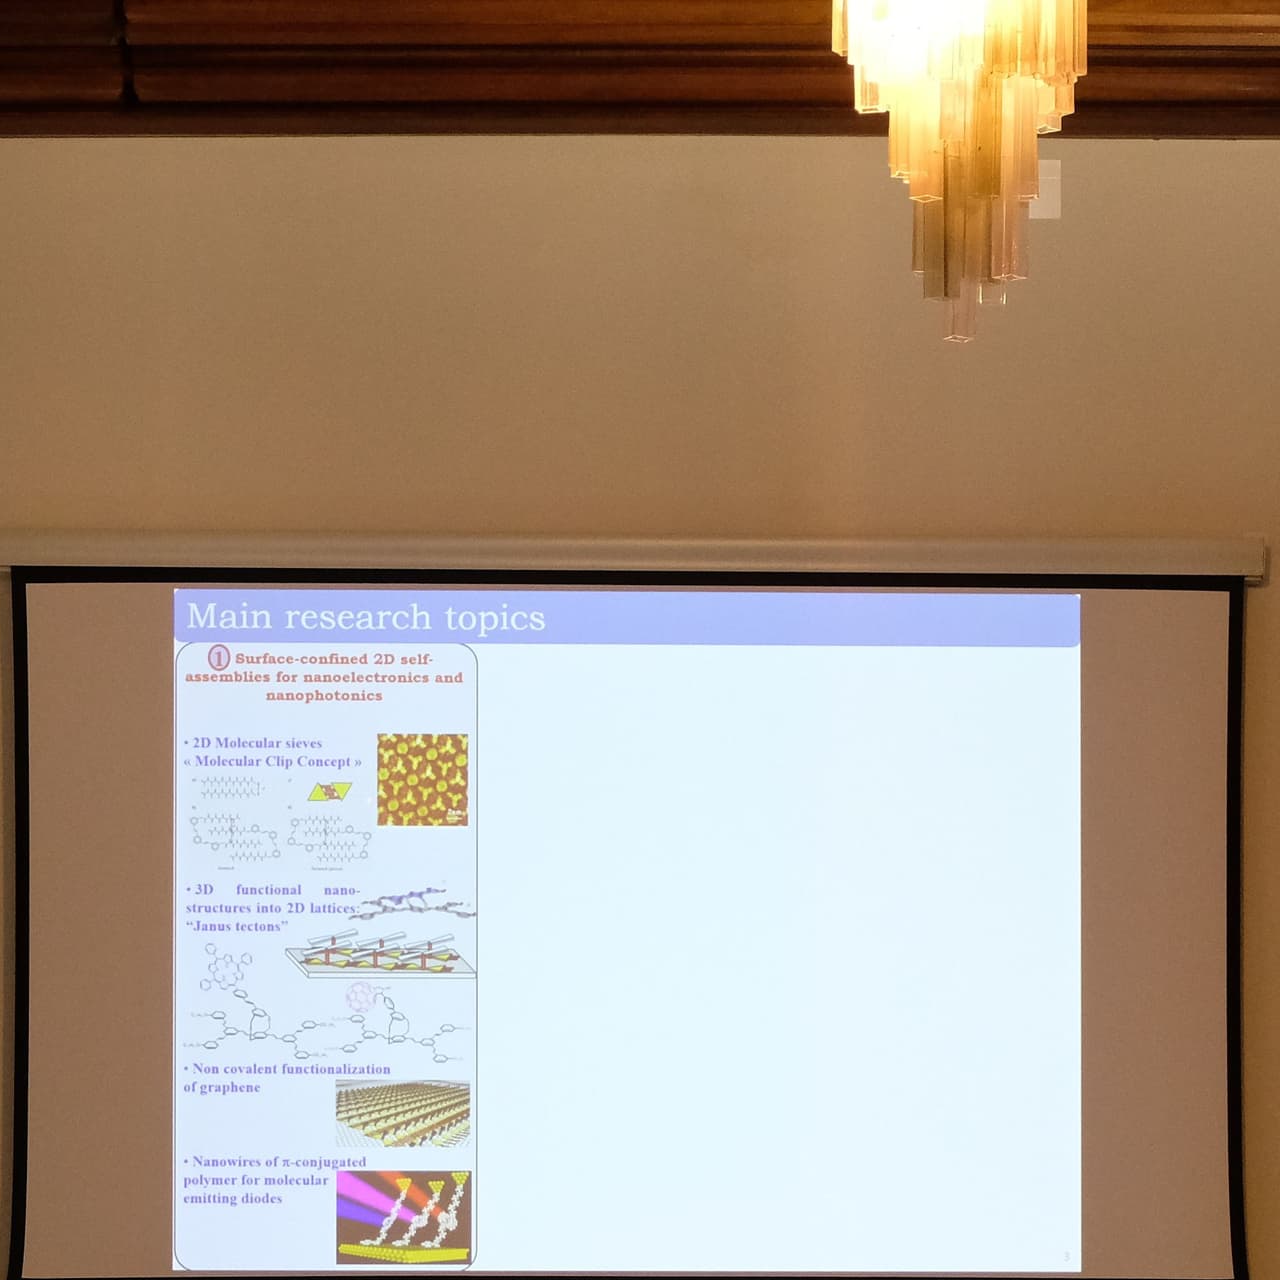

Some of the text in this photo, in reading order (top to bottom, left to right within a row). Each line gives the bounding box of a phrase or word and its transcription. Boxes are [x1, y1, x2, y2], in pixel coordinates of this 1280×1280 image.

[188, 602, 545, 638] Main research topics
[236, 653, 368, 665] Surface-confined
[374, 654, 395, 665] 2D
[401, 653, 433, 665] self-
[186, 670, 463, 684] assemblies for nanoelectronics and
[266, 690, 382, 705] nanophotonics
[194, 737, 322, 749] 2D Molecular sieves
[196, 755, 261, 768] Molecular
[266, 756, 292, 771] Clip
[297, 756, 350, 771] Concept
[195, 884, 360, 896] 3D functional nano-
[186, 904, 251, 914] structures
[257, 903, 281, 914] into
[288, 903, 304, 914] 2D
[193, 1063, 390, 1075] Non covalent functionalization
[184, 1081, 260, 1096] of graphene
[193, 1156, 261, 1168] Nanowires
[266, 1156, 279, 1168] of
[184, 1175, 328, 1189] polymer for molecular
[184, 1193, 282, 1207] emitting diodes
